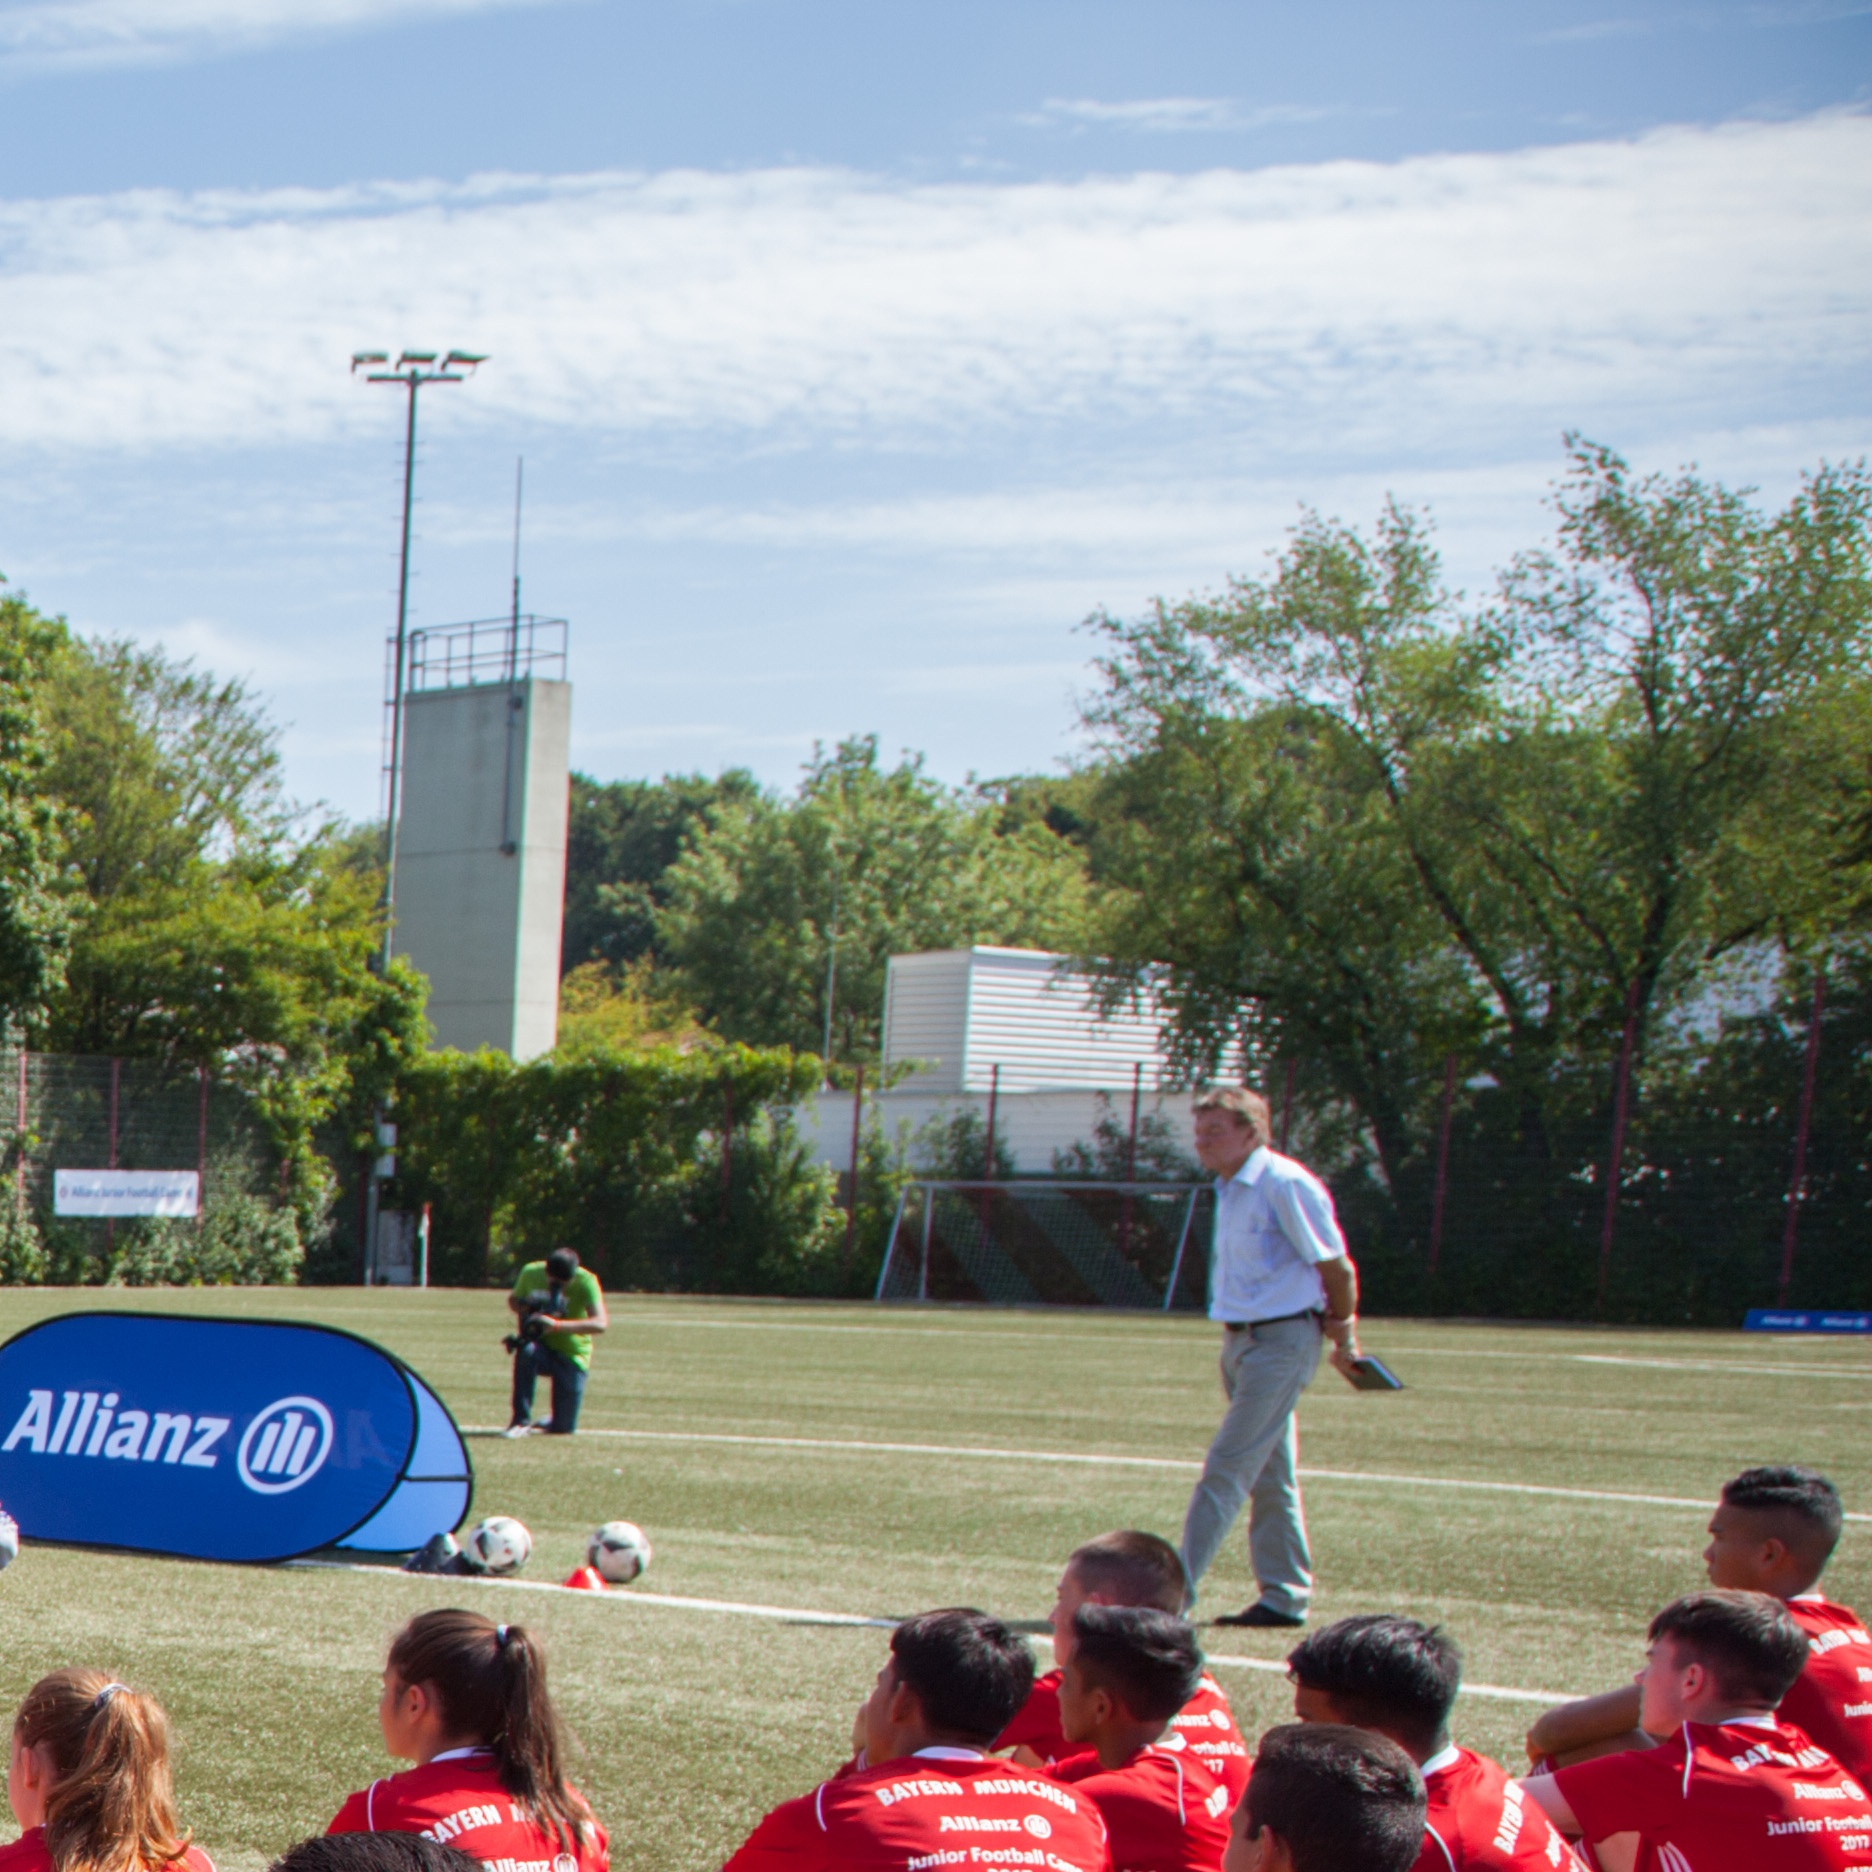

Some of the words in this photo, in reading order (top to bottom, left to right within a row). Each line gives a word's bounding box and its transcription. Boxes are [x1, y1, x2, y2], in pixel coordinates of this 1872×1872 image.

[1, 1390, 230, 1468] Allianz
[875, 1779, 963, 1807] BAYERN
[938, 1814, 1023, 1834] Allianz
[1766, 1816, 1822, 1836] Junior
[1839, 1835, 1870, 1852] 2017
[906, 1847, 967, 1872] Junior
[969, 1846, 1046, 1867] Football
